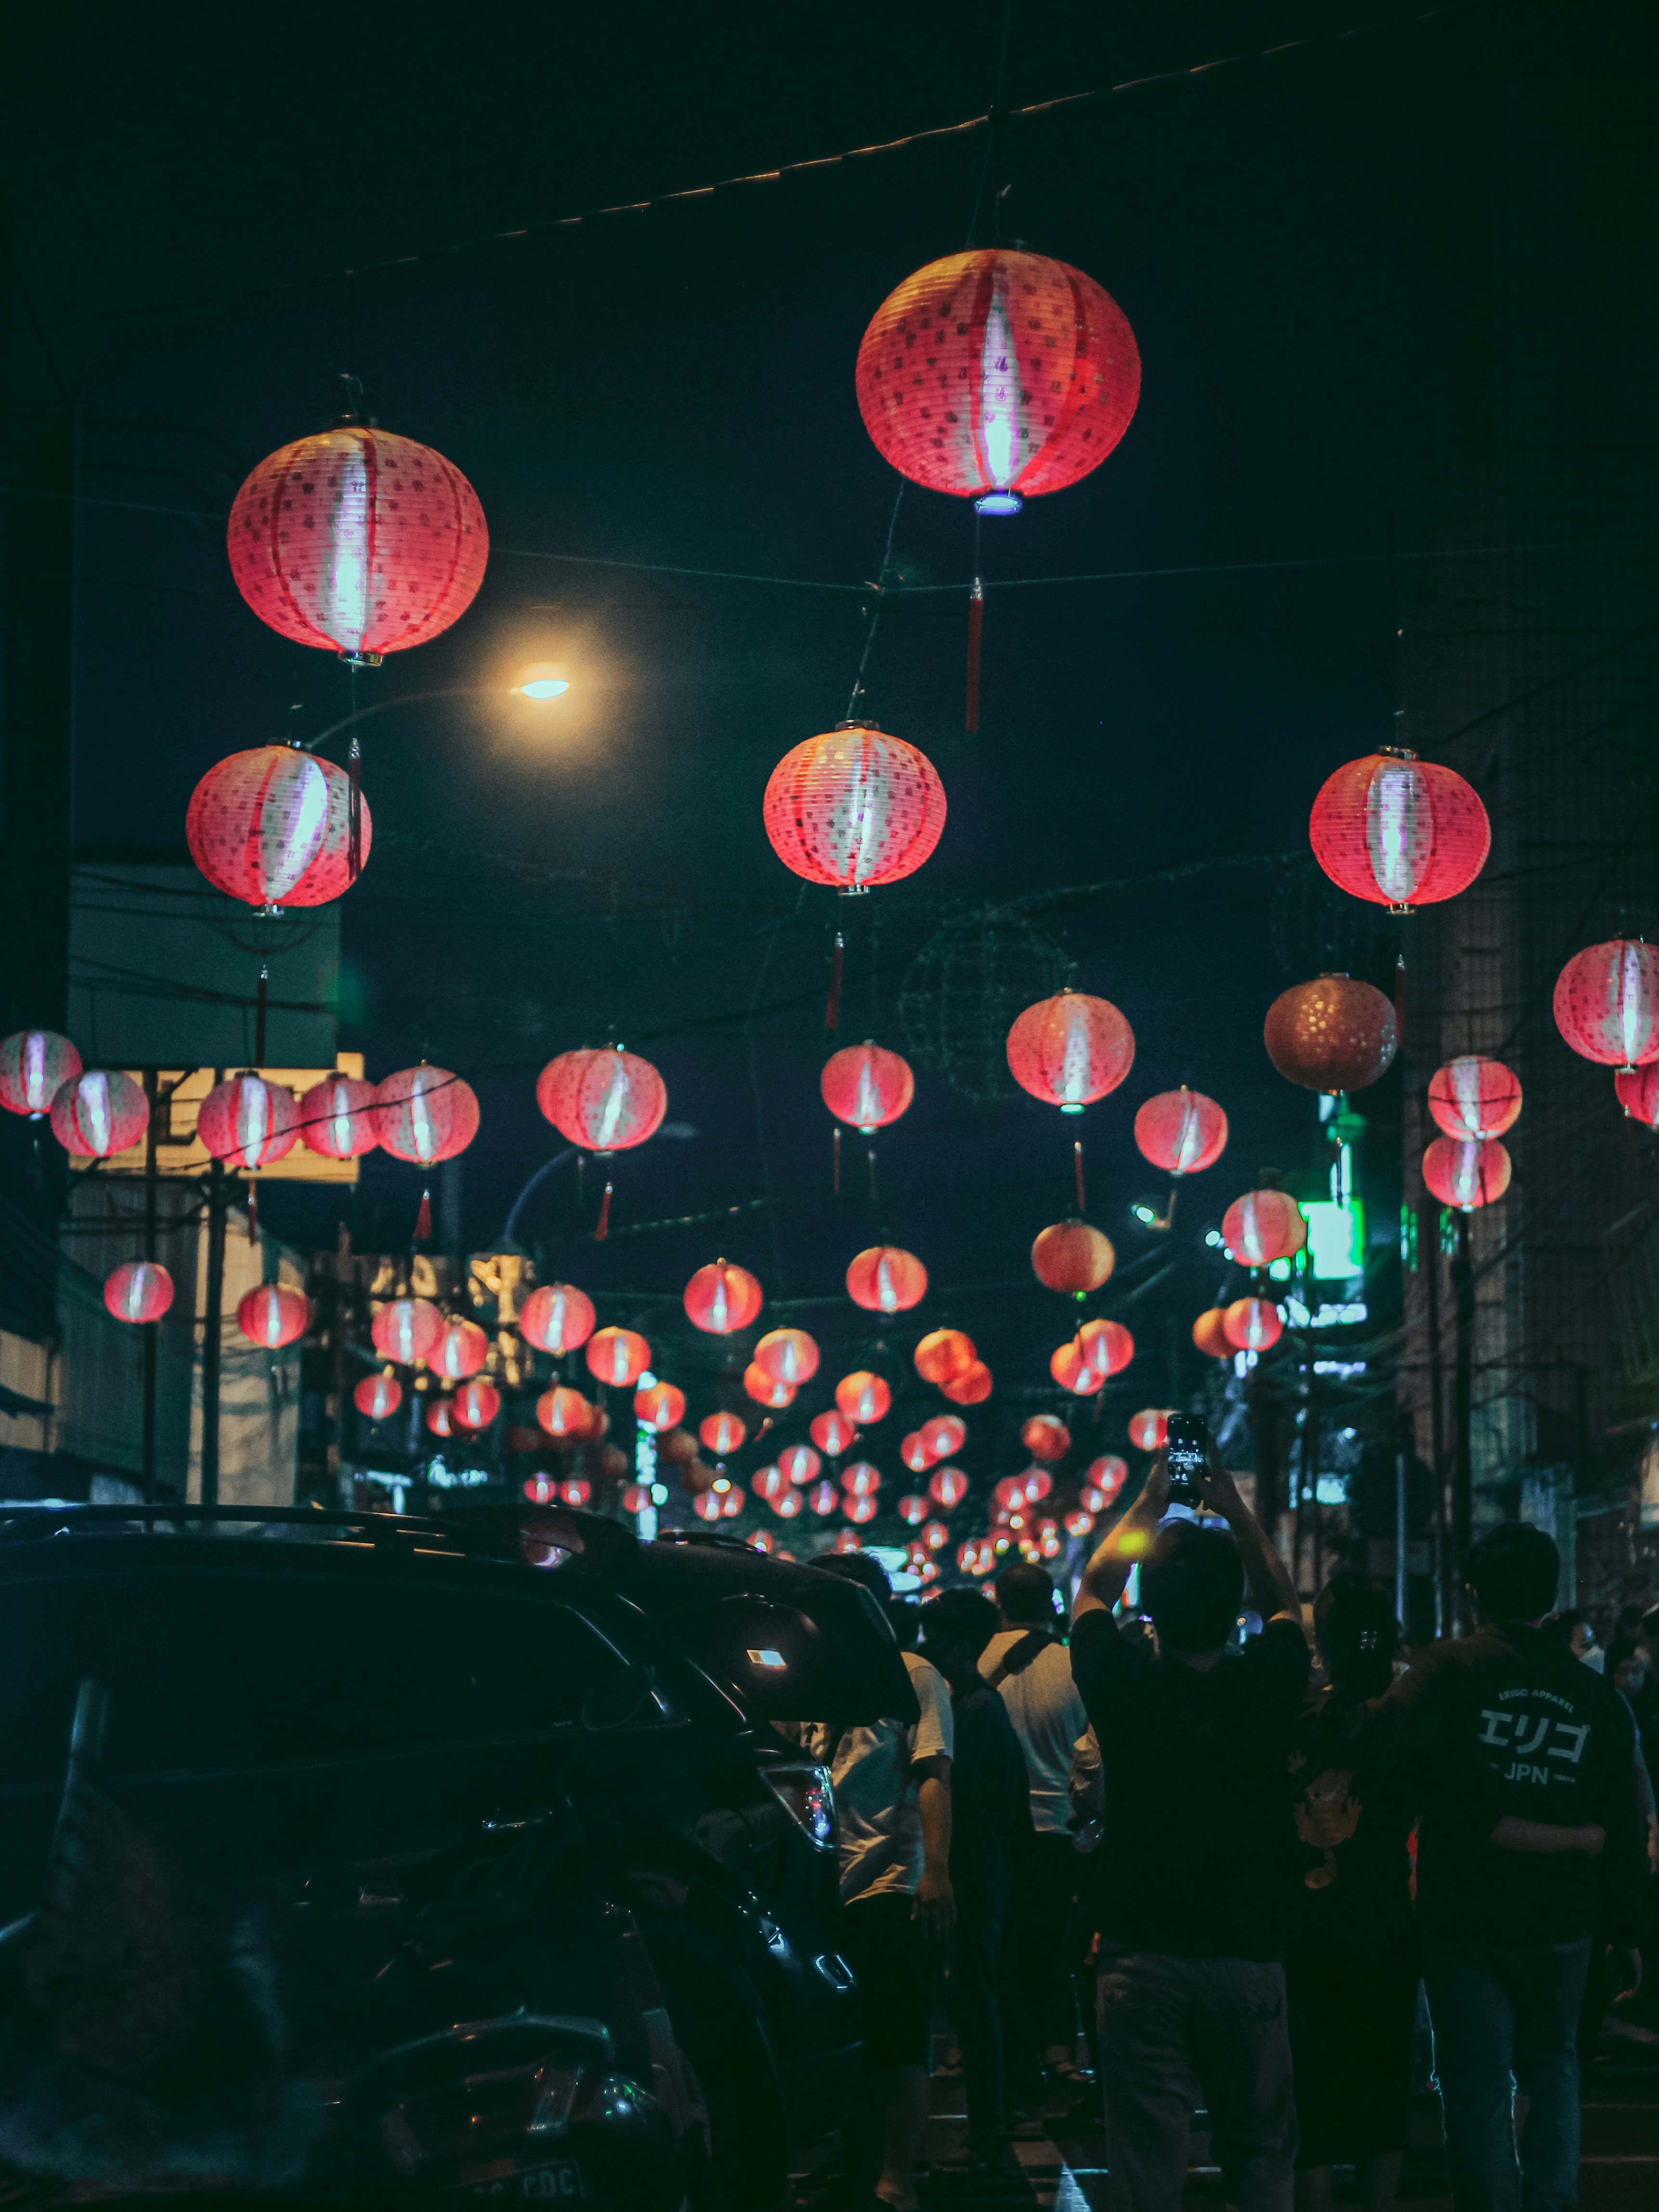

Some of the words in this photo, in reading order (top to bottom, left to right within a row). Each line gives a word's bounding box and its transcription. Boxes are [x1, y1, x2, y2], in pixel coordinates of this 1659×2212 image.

[1498, 1689, 1529, 1700] ERIGO
[1532, 1689, 1574, 1713] APPAREL
[1503, 1762, 1549, 1784] JPN
